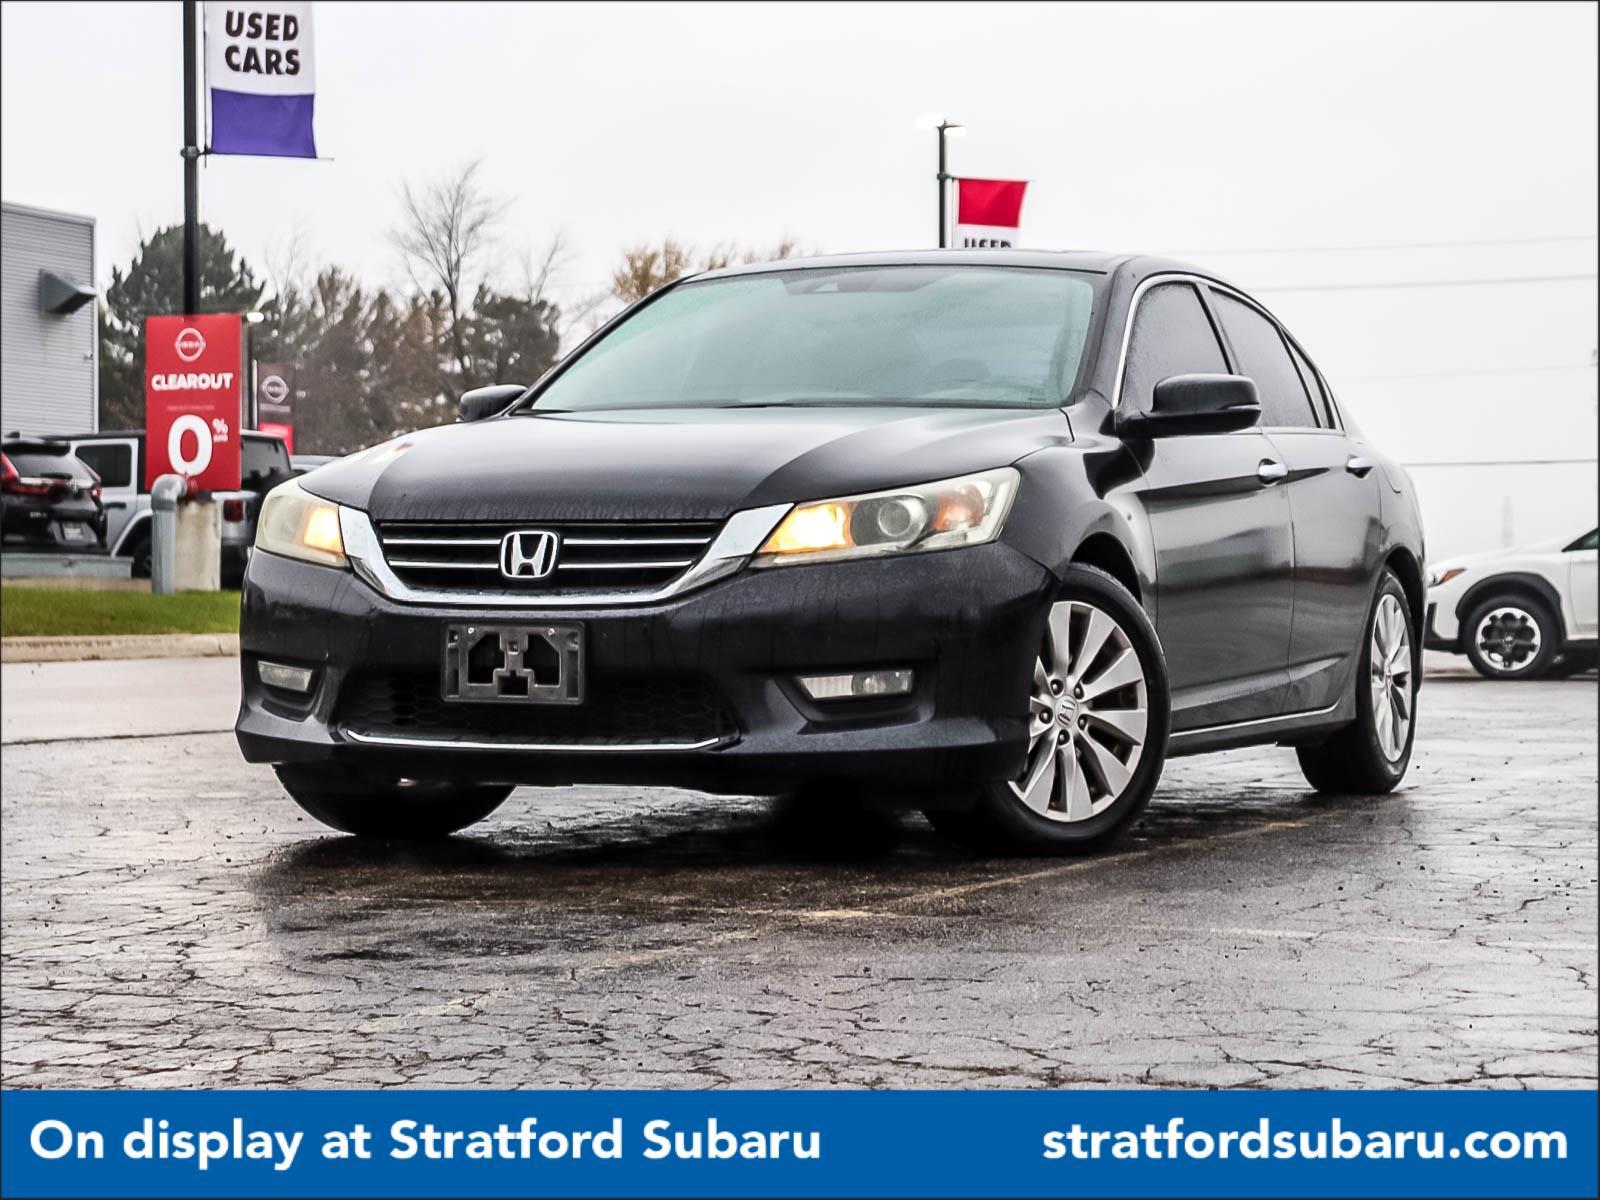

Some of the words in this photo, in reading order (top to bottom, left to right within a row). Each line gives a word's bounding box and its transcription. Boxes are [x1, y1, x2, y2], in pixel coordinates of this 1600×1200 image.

[225, 10, 299, 41] USED
[225, 45, 301, 75] CARS
[151, 372, 234, 391] CLEAROUT
